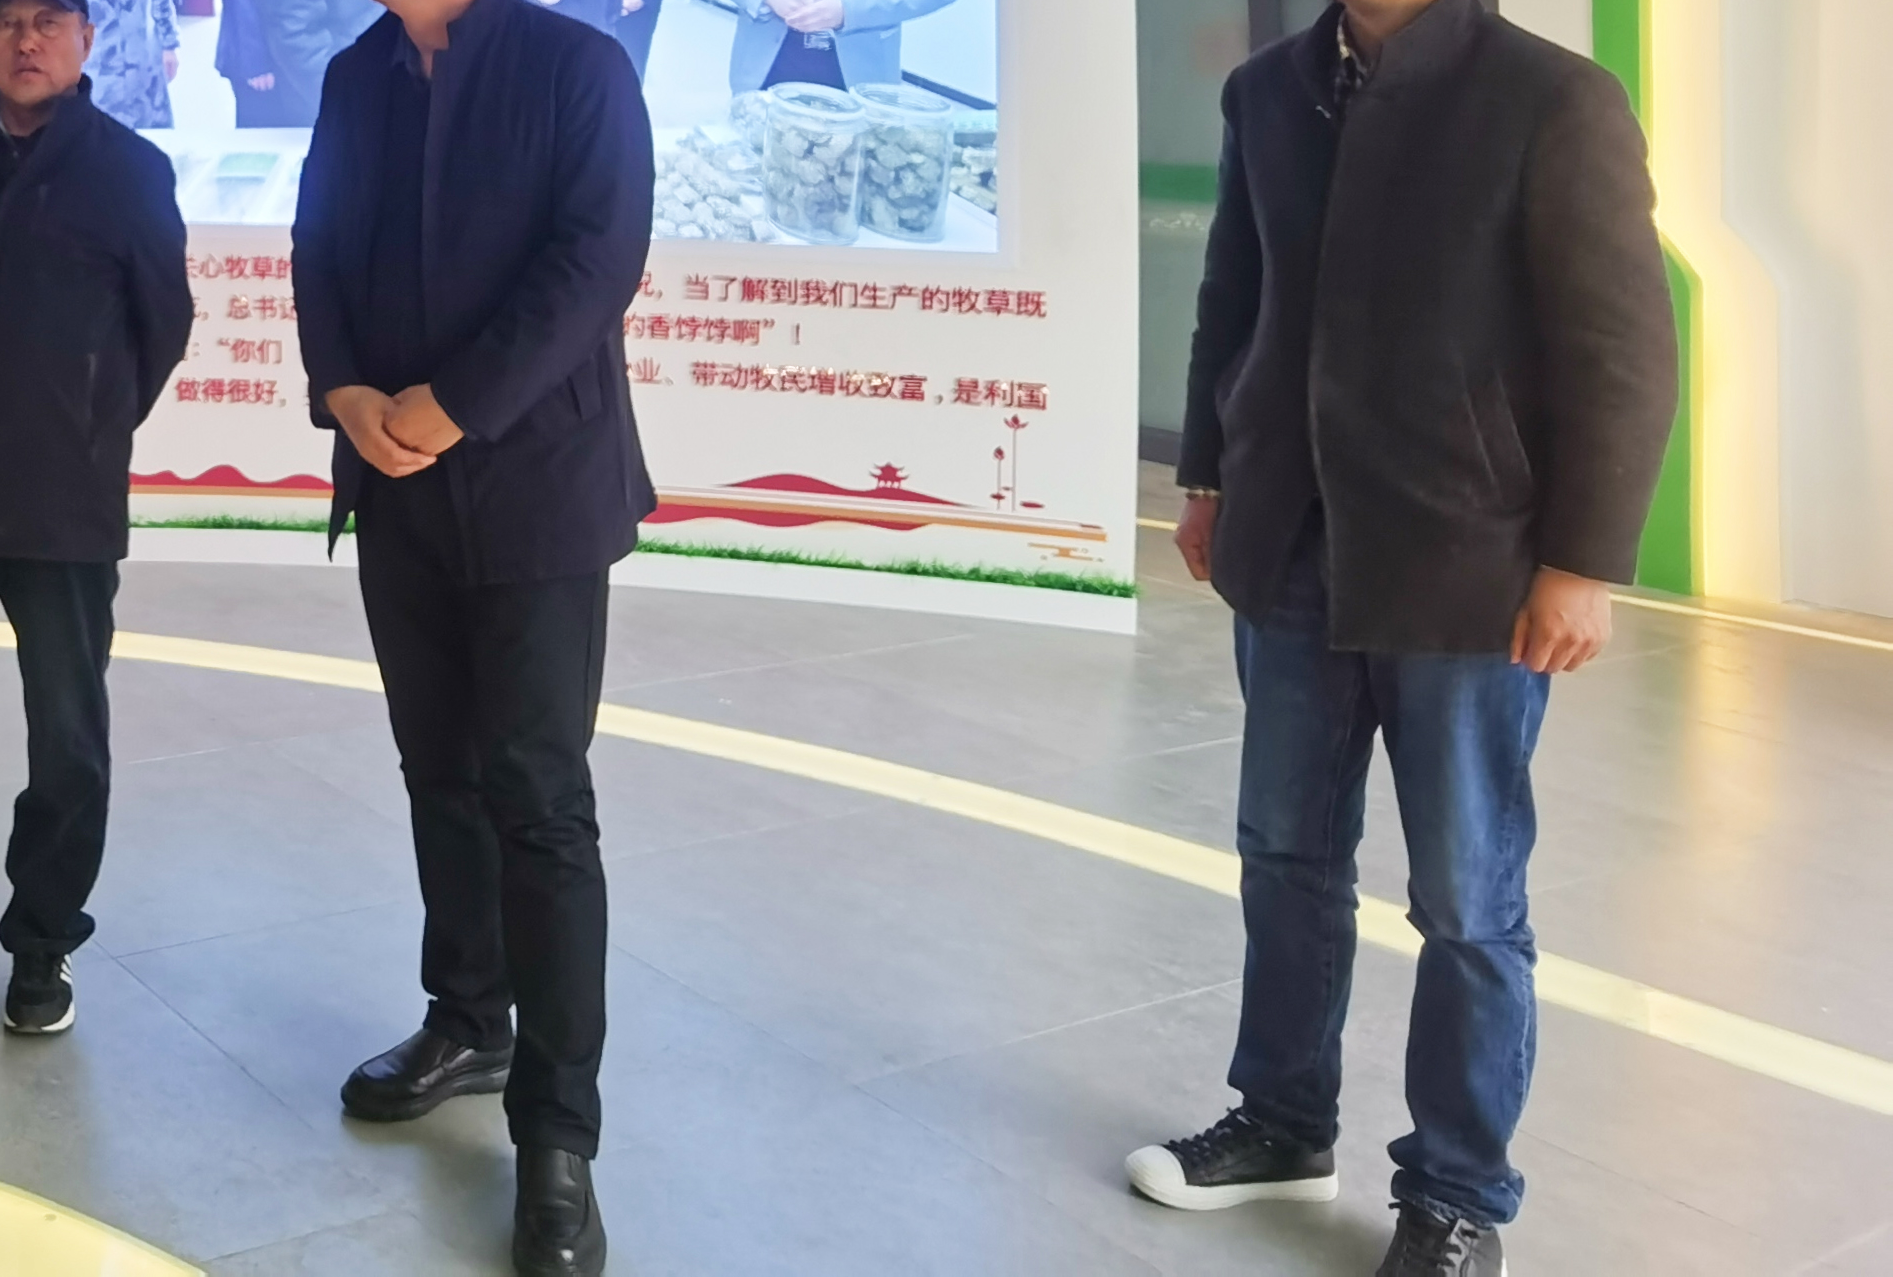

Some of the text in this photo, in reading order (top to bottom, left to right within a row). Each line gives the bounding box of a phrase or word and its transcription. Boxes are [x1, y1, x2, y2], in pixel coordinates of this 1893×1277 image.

[175, 377, 310, 408] 做得很好，
[626, 357, 1049, 411] 业、带动牧民增收致富，是利国
